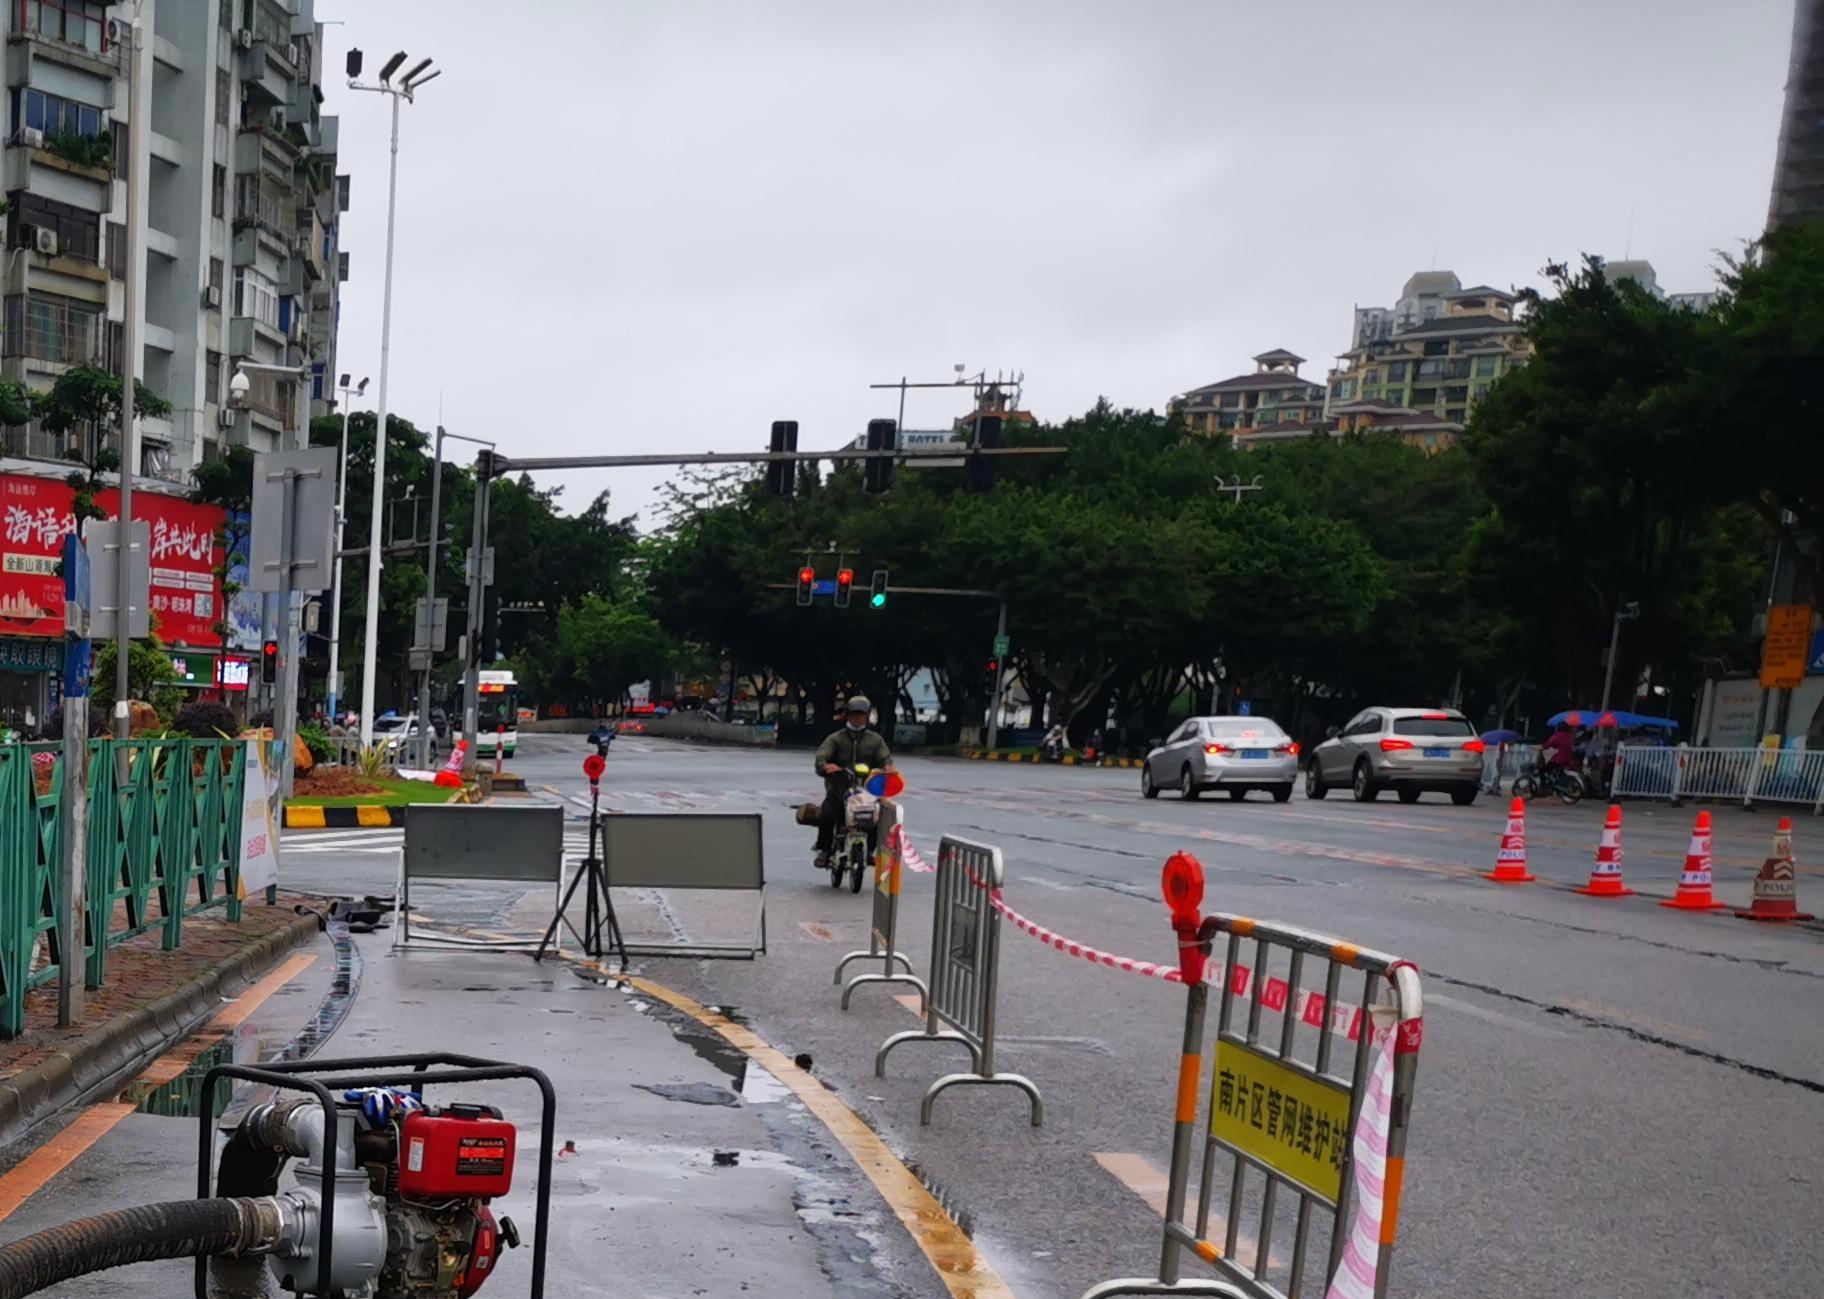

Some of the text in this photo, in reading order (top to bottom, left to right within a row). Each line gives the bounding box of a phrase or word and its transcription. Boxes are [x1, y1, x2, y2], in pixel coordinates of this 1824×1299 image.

[1219, 1067, 1350, 1173] 南片区管网维护站
